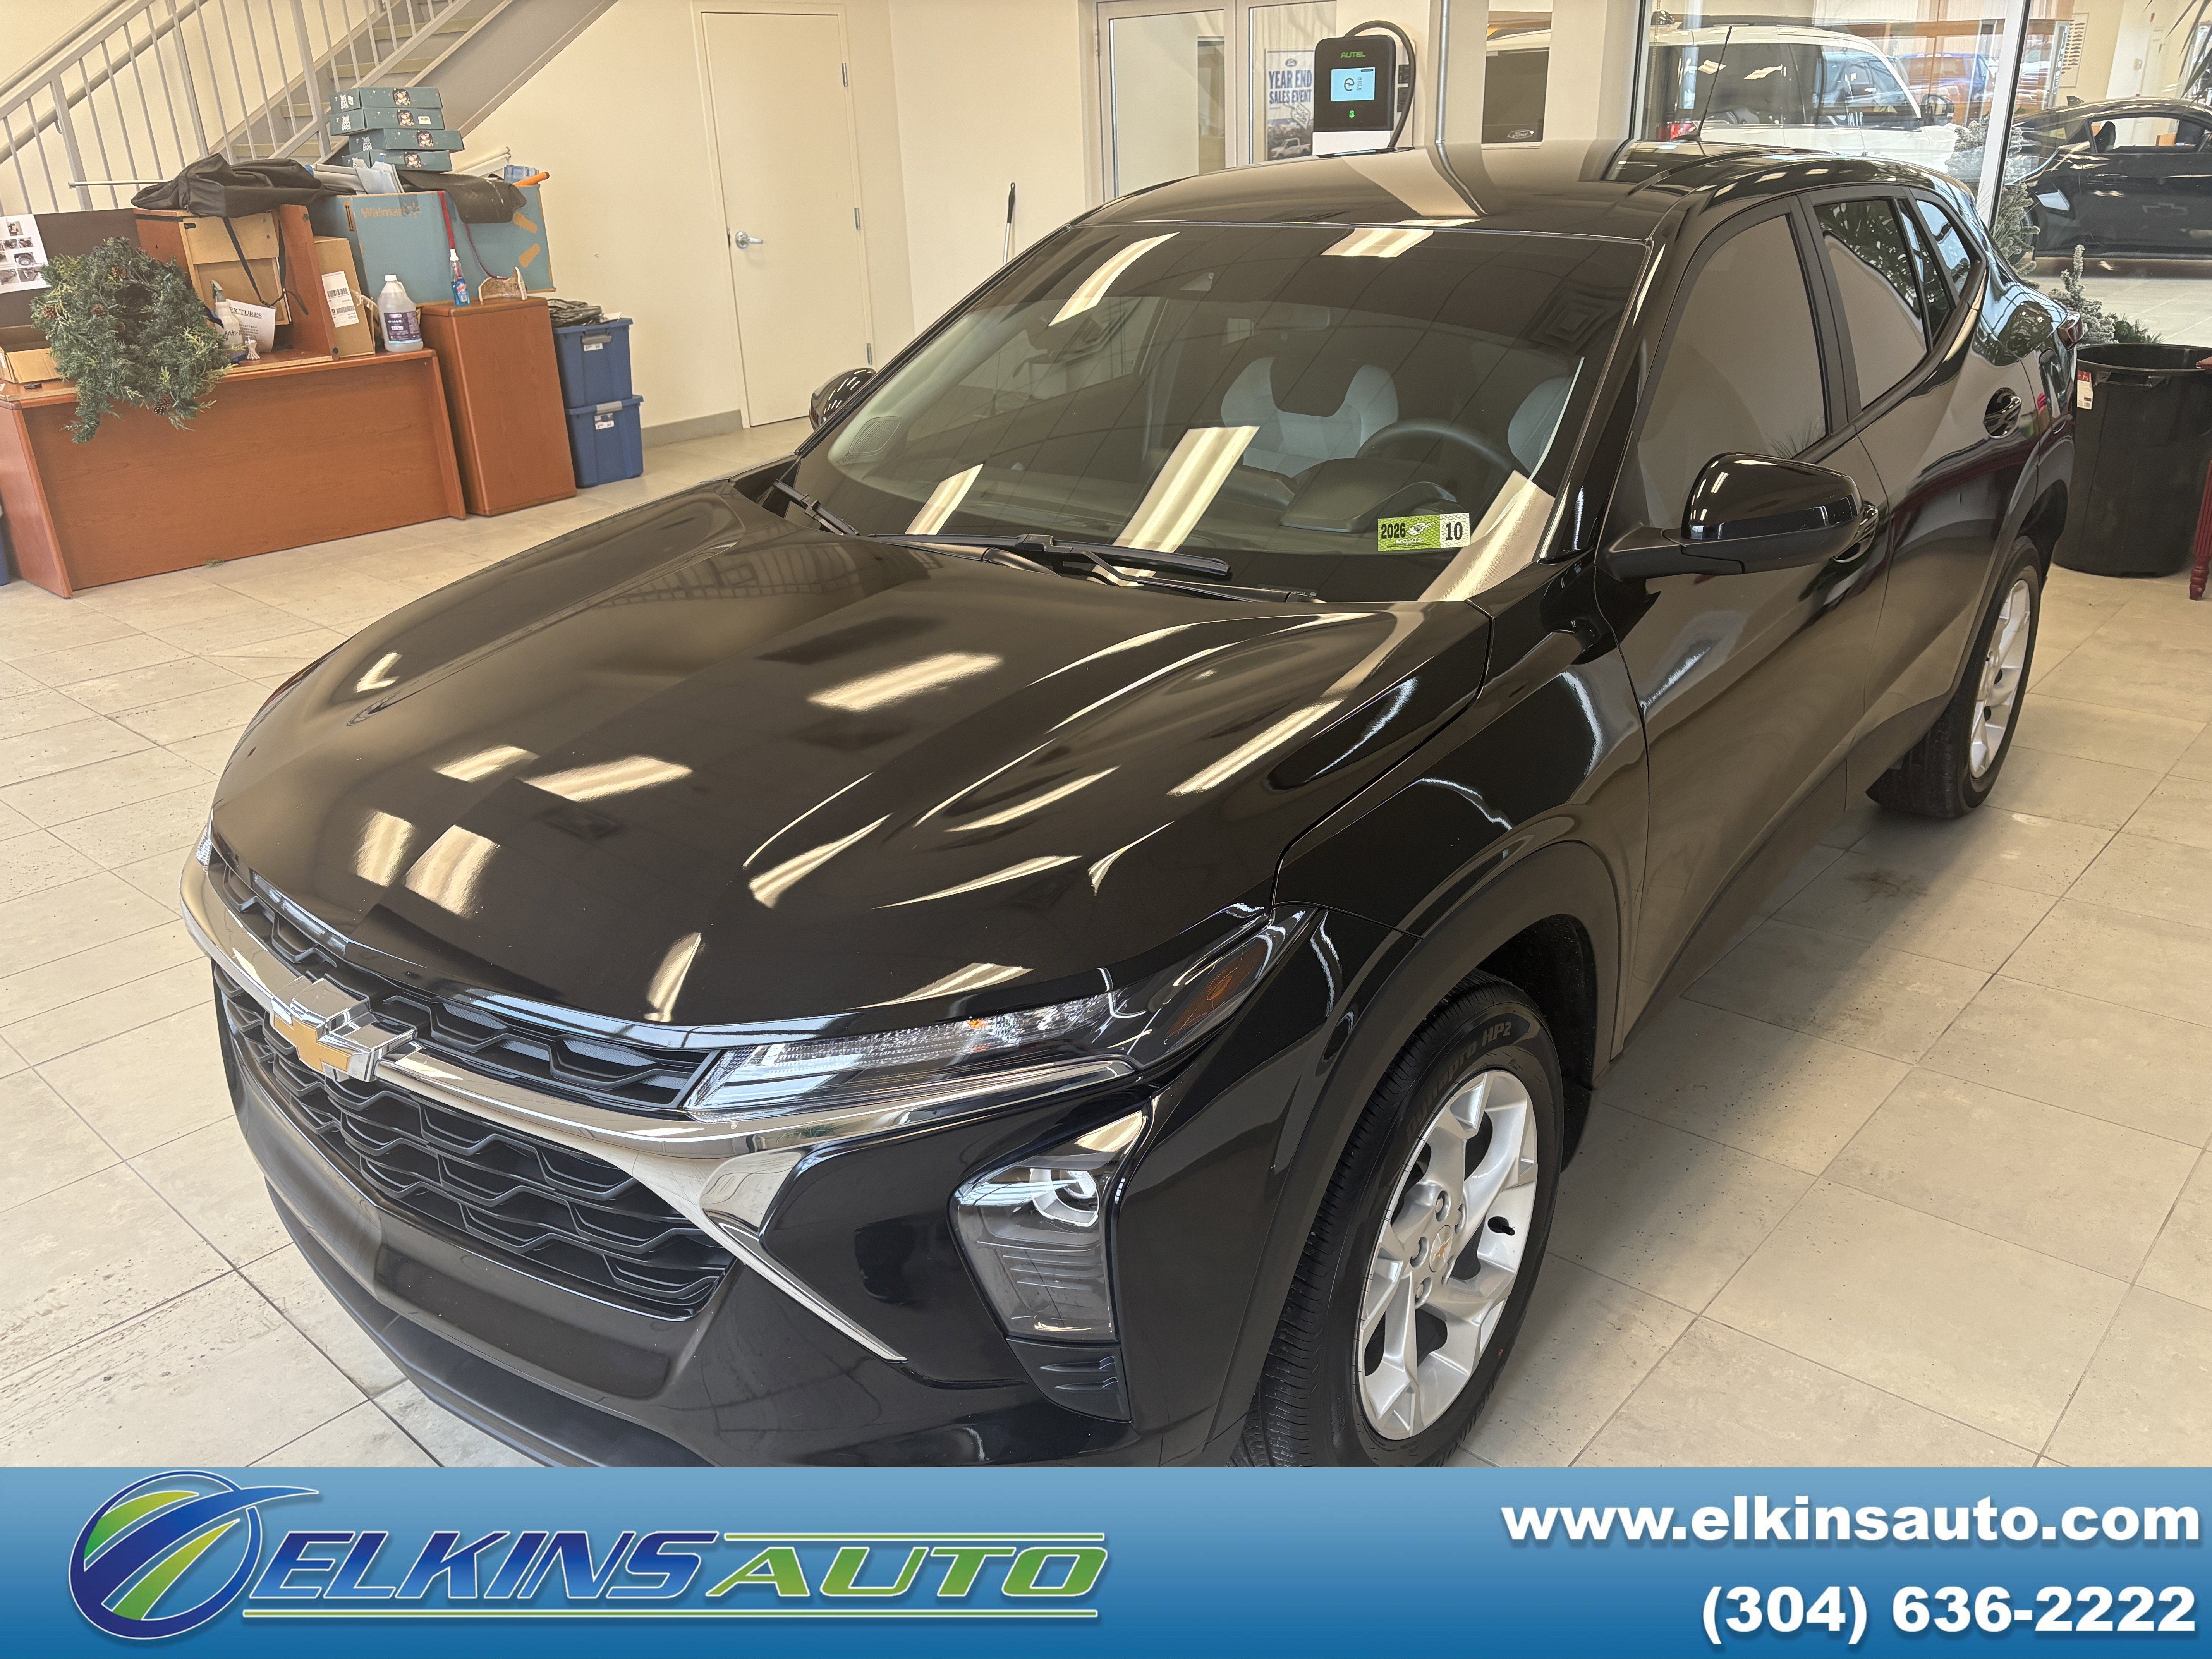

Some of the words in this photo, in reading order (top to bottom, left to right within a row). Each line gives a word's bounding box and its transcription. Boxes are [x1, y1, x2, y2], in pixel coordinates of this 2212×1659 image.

[1269, 70, 1293, 89] YEAR
[1295, 70, 1312, 88] END
[1269, 90, 1290, 104] SALES
[1291, 89, 1312, 103] EVENT
[361, 206, 407, 218] Walmart
[229, 307, 263, 318] PICTURES
[1381, 522, 1406, 539] 2026
[1446, 522, 1463, 541] 10
[1481, 1021, 1512, 1047] HP2
